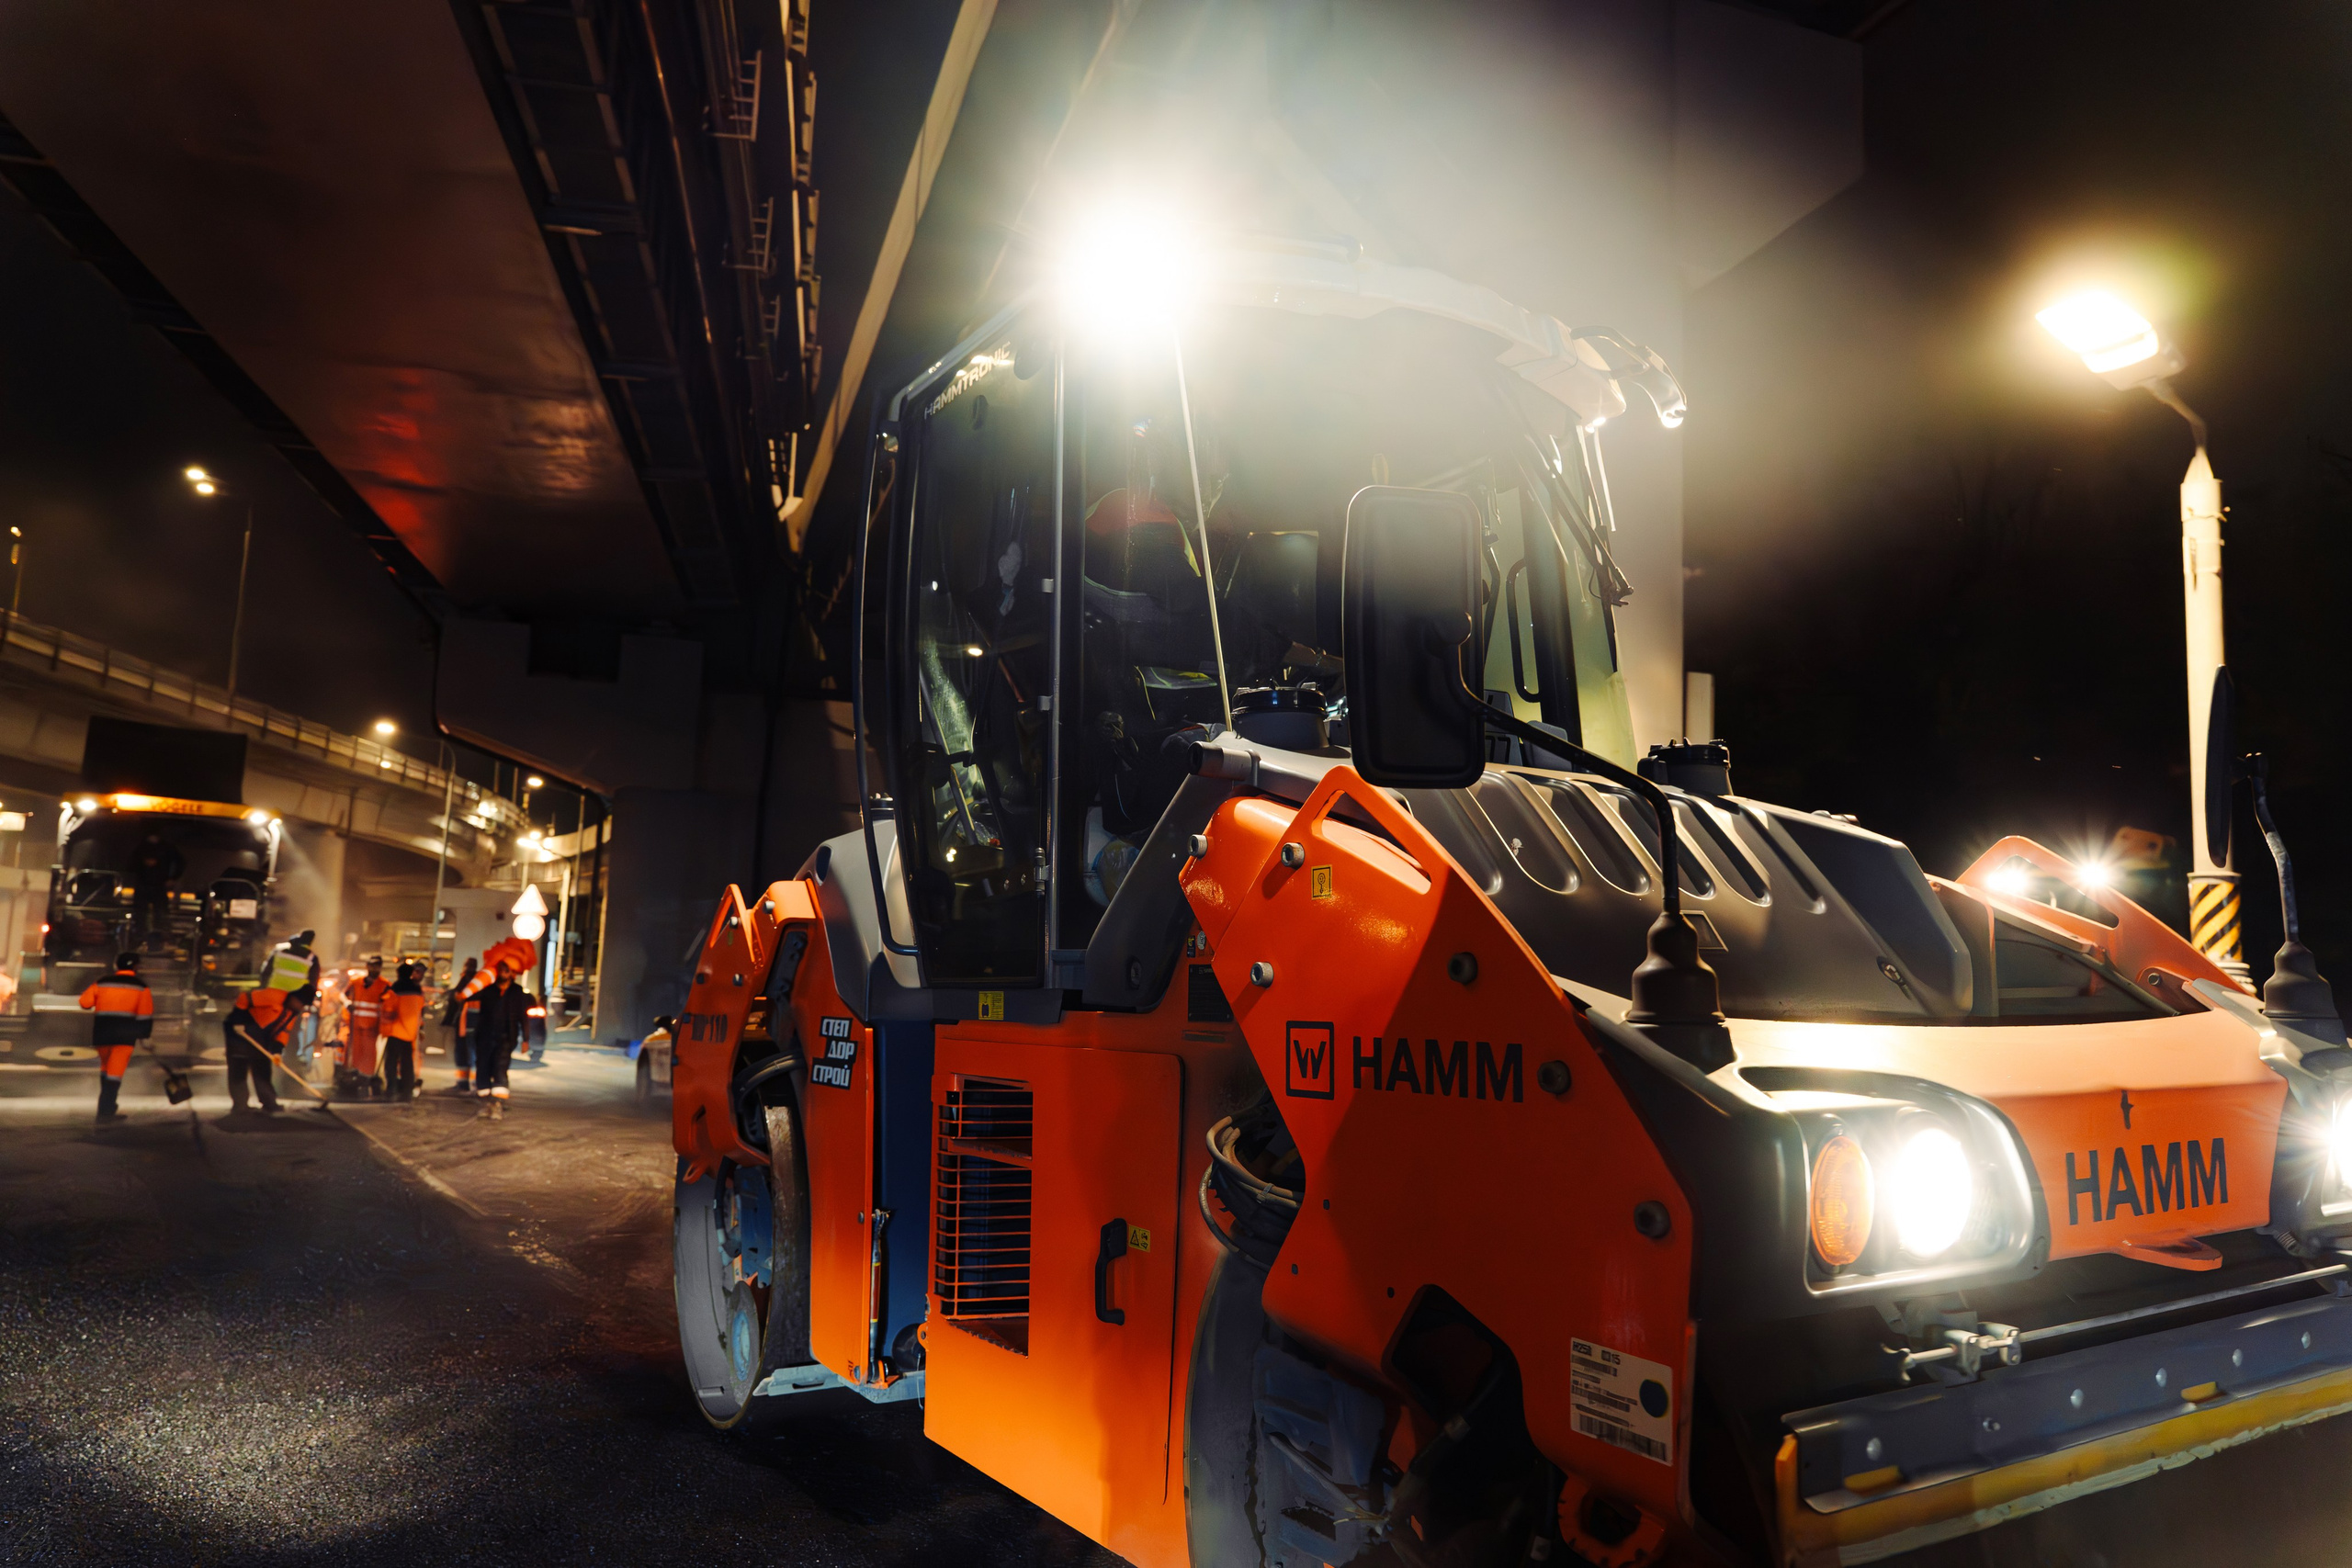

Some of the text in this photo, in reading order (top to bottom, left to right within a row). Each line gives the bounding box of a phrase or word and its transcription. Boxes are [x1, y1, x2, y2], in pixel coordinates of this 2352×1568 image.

[924, 341, 1011, 420] HAMMTRONIC
[821, 1018, 851, 1038] СТЕП
[828, 1040, 855, 1060] ДОР
[812, 1065, 851, 1087] СТРОЙ
[1352, 1035, 1524, 1103] HAMM
[2065, 1137, 2229, 1225] HAMM
